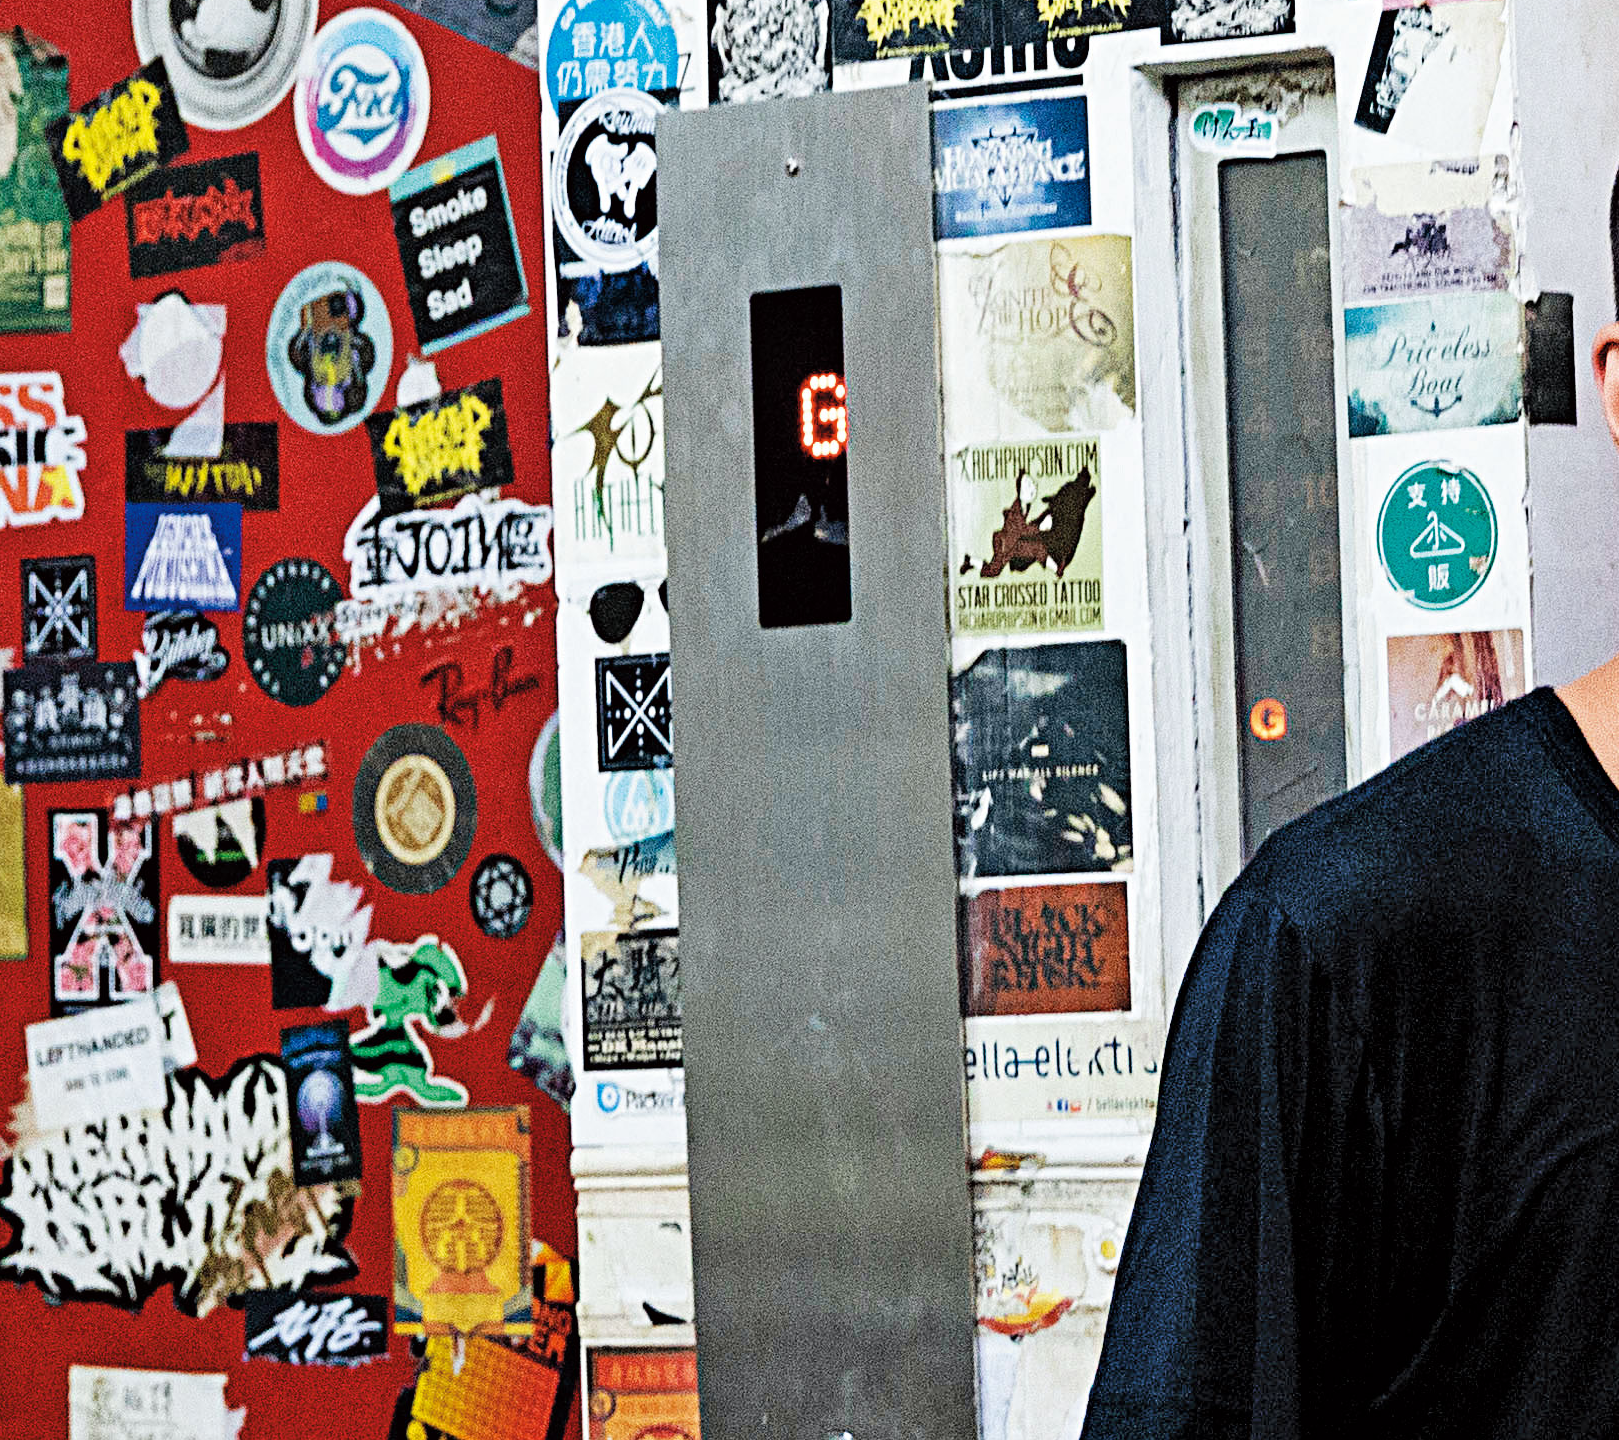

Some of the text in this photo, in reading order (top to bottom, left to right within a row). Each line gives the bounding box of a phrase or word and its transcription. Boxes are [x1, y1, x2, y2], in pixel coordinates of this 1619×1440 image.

[571, 22, 658, 60] 香港人
[408, 181, 489, 240] Smoke
[416, 234, 484, 280] Sleep
[425, 278, 474, 322] Sad
[1379, 331, 1493, 367] Priceless
[1406, 479, 1462, 511] 支持
[958, 577, 1101, 609] STAR CROSSED TATTOO
[1250, 697, 1288, 741] G
[36, 1024, 151, 1067] LEFTHANDED
